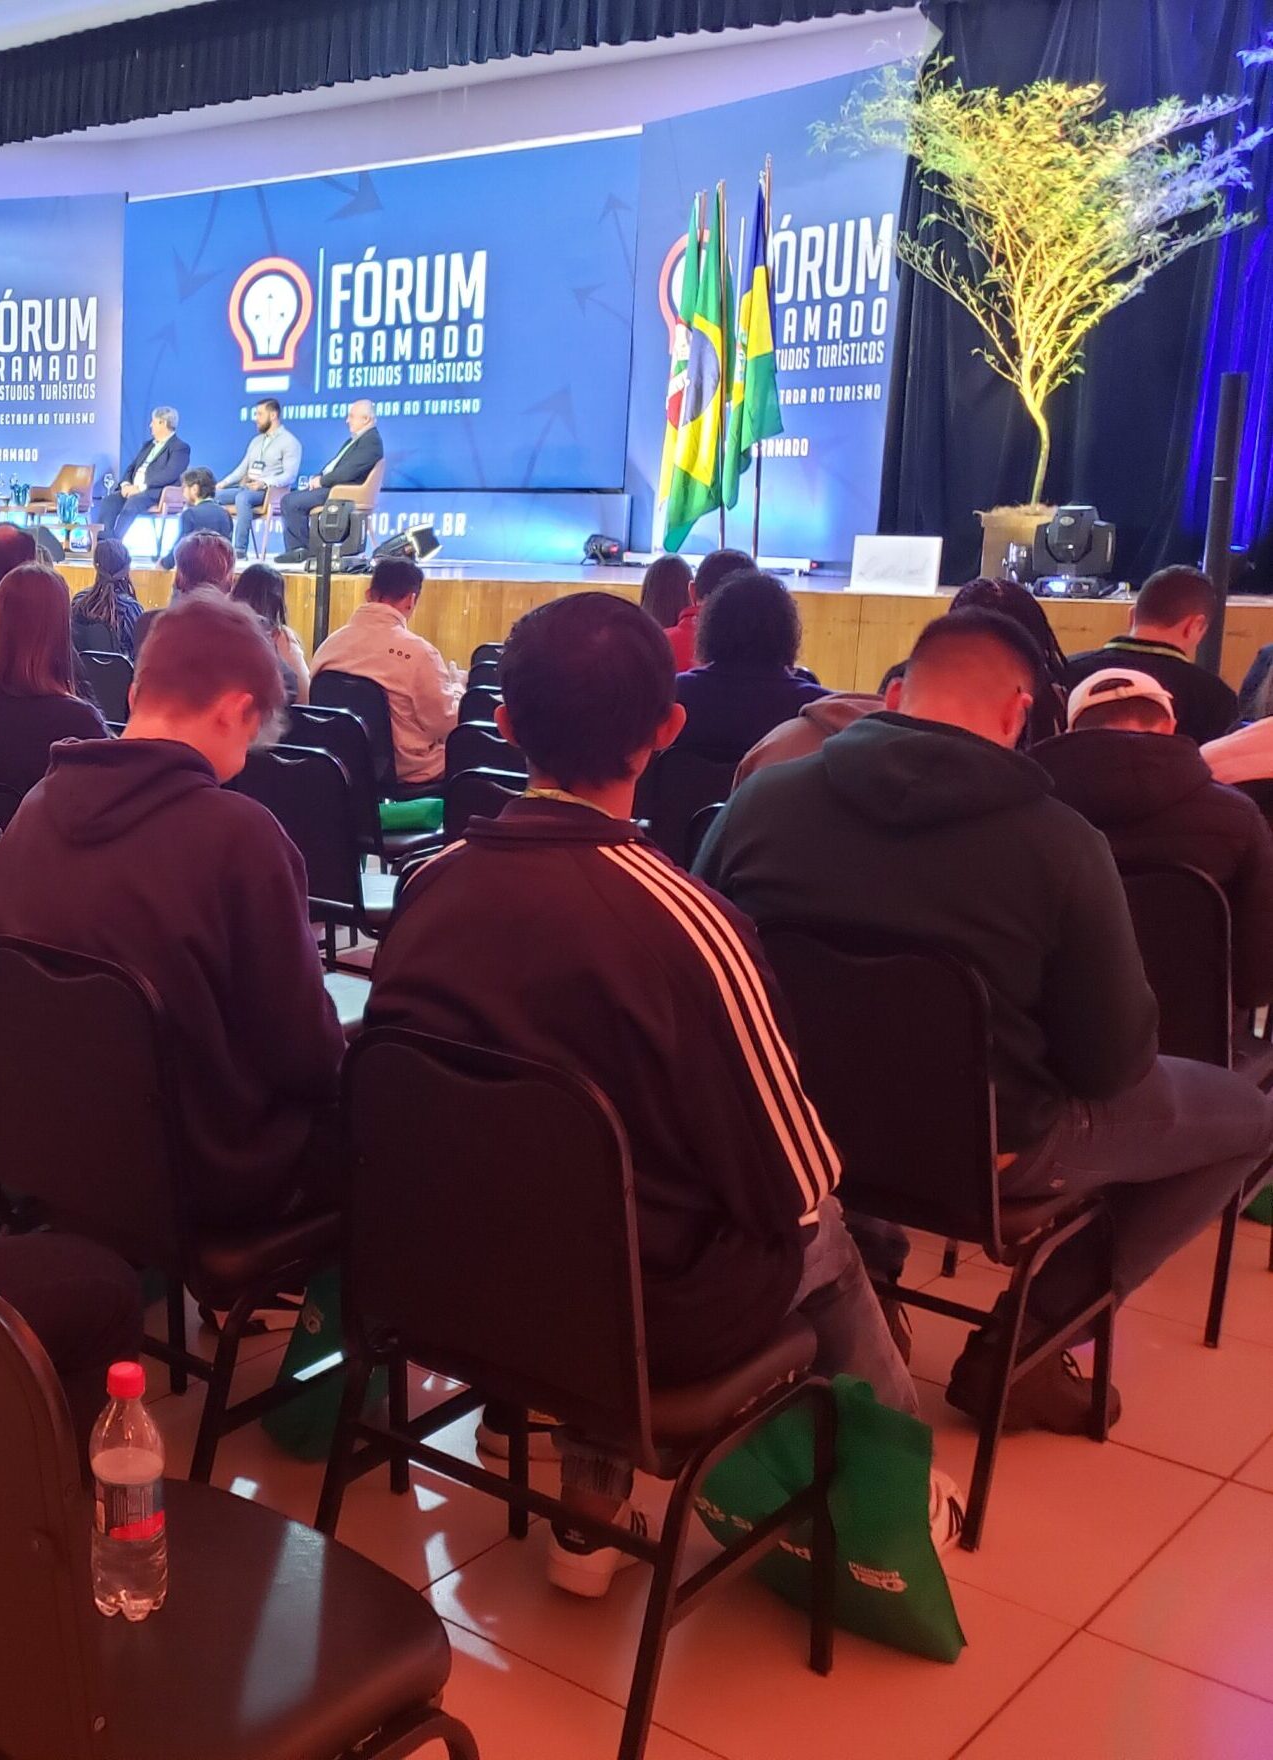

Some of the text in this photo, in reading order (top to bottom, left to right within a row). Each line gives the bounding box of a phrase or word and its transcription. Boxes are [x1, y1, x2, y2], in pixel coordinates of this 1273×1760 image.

[772, 212, 894, 305] ÓRUM
[329, 246, 488, 330] FÓRUM
[783, 297, 888, 345] AMADO
[328, 323, 484, 366] GRAMADO
[815, 339, 885, 369] TURÍSTICOS
[327, 359, 482, 389] DE ESTUDOS TURÍSTICOS
[40, 380, 96, 400] TURÍSTICOS
[810, 386, 826, 404] AO
[829, 382, 882, 403] TURISMO
[37, 413, 50, 425] AO
[53, 412, 95, 425] TURISMO
[240, 407, 248, 421] A
[403, 400, 421, 416] AO
[424, 398, 481, 415] TURISMO
